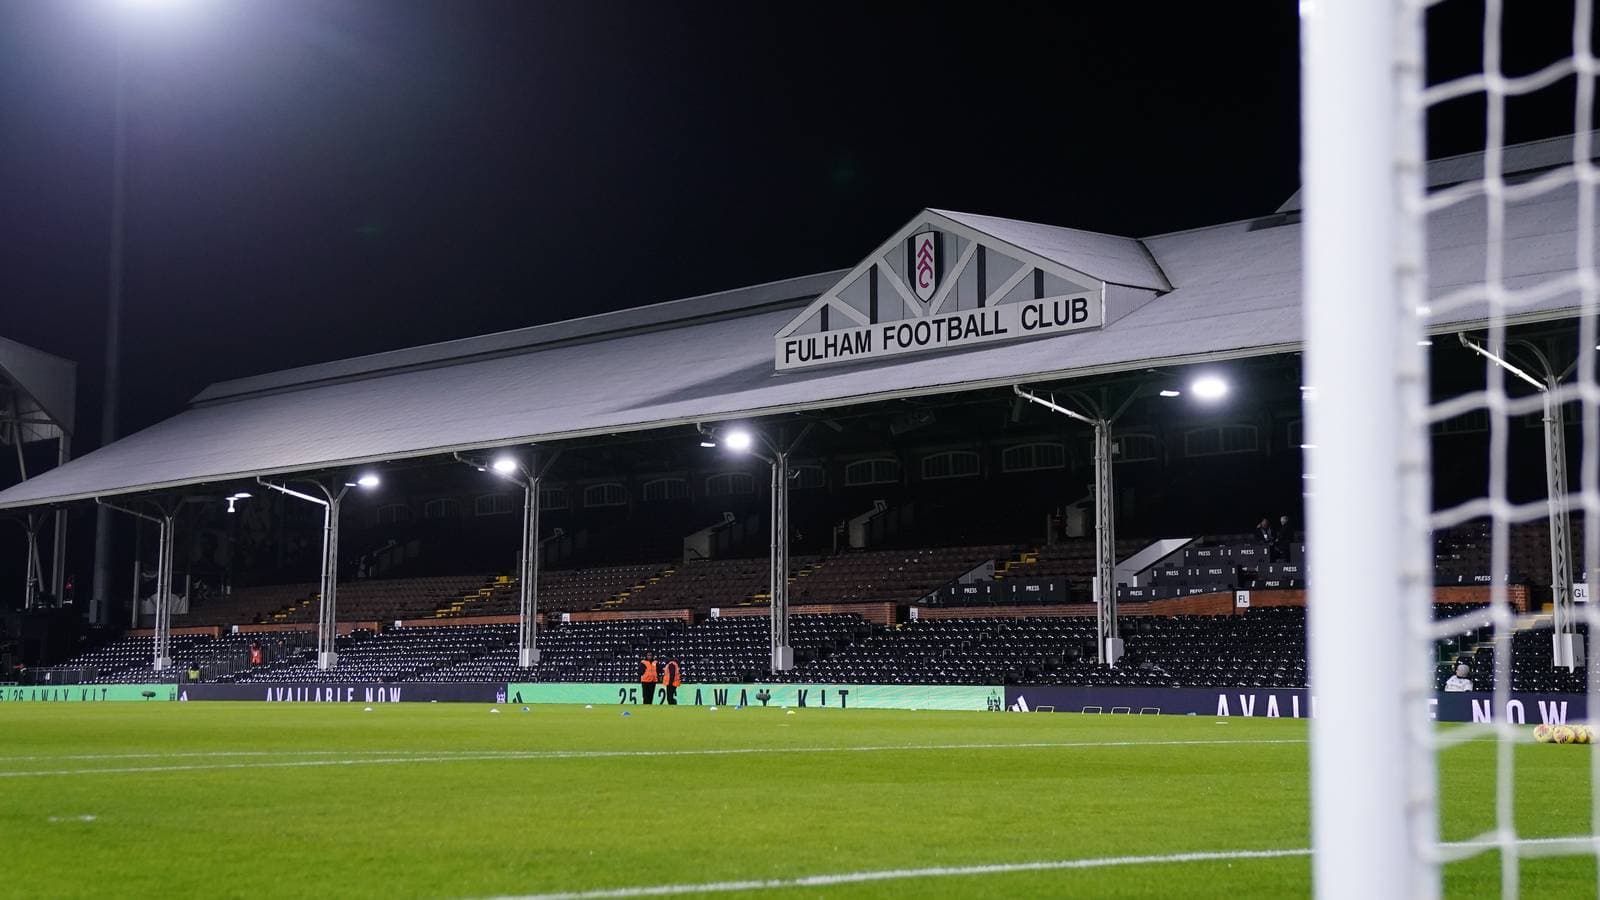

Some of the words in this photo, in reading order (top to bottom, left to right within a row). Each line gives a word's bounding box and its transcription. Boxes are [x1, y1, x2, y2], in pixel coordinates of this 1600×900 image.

[785, 329, 872, 364] FULHAM
[883, 310, 1007, 350] FOOTBALL
[1021, 297, 1088, 331] CLUB
[1238, 595, 1248, 603] FL
[1574, 588, 1587, 598] GL
[32, 688, 69, 702] AWAY
[82, 688, 107, 701] KIT
[266, 687, 354, 702] AVAILABLE
[365, 687, 401, 702] NOW
[695, 688, 770, 706] AWAY
[798, 689, 849, 708] KIT
[1471, 699, 1568, 725] NOW
